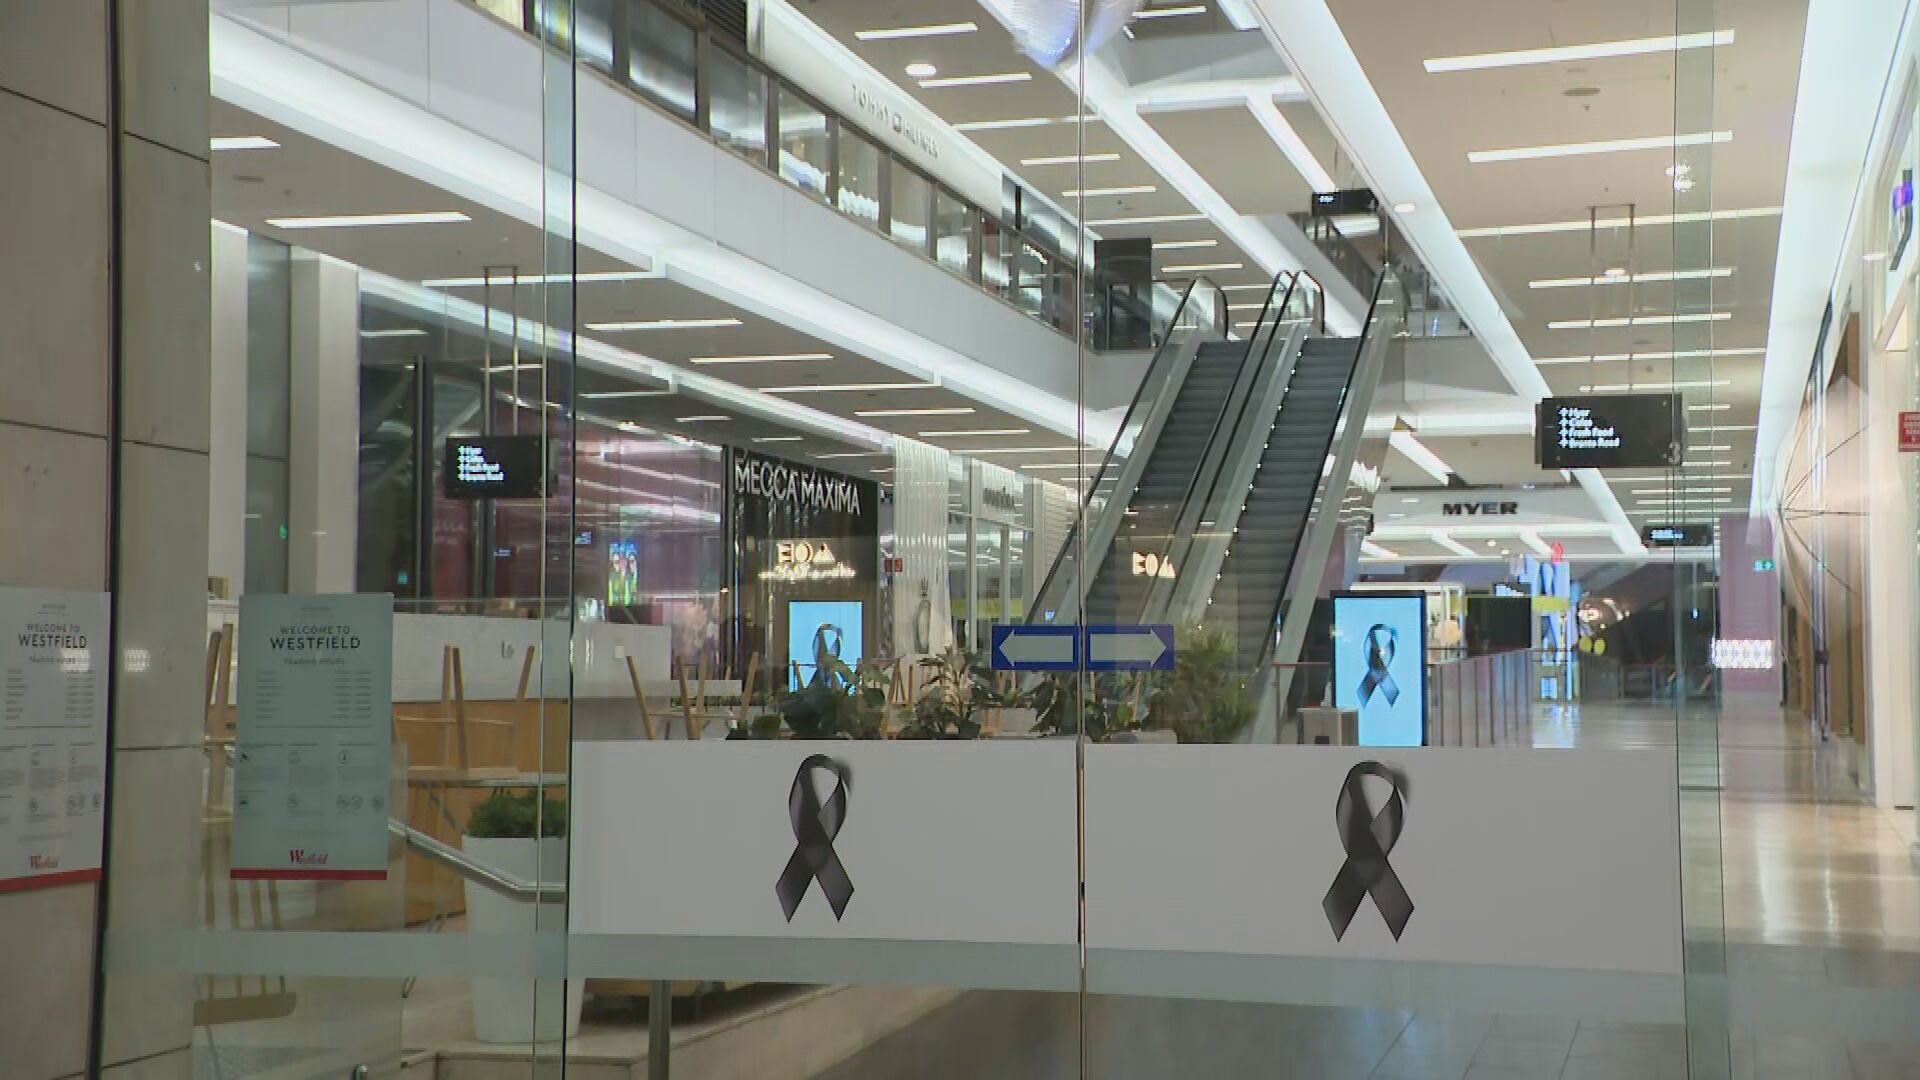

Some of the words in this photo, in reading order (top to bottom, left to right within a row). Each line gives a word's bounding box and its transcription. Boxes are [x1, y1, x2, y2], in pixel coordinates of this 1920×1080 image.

[734, 457, 799, 504] MECCA
[801, 472, 861, 515] MAXIMA
[1443, 502, 1519, 515] MYER
[25, 624, 66, 632] WELCOME
[280, 626, 334, 635] WELCOME
[338, 626, 350, 635] TO
[18, 634, 88, 649] WESTFIELD
[270, 637, 361, 650] WESTFIELD
